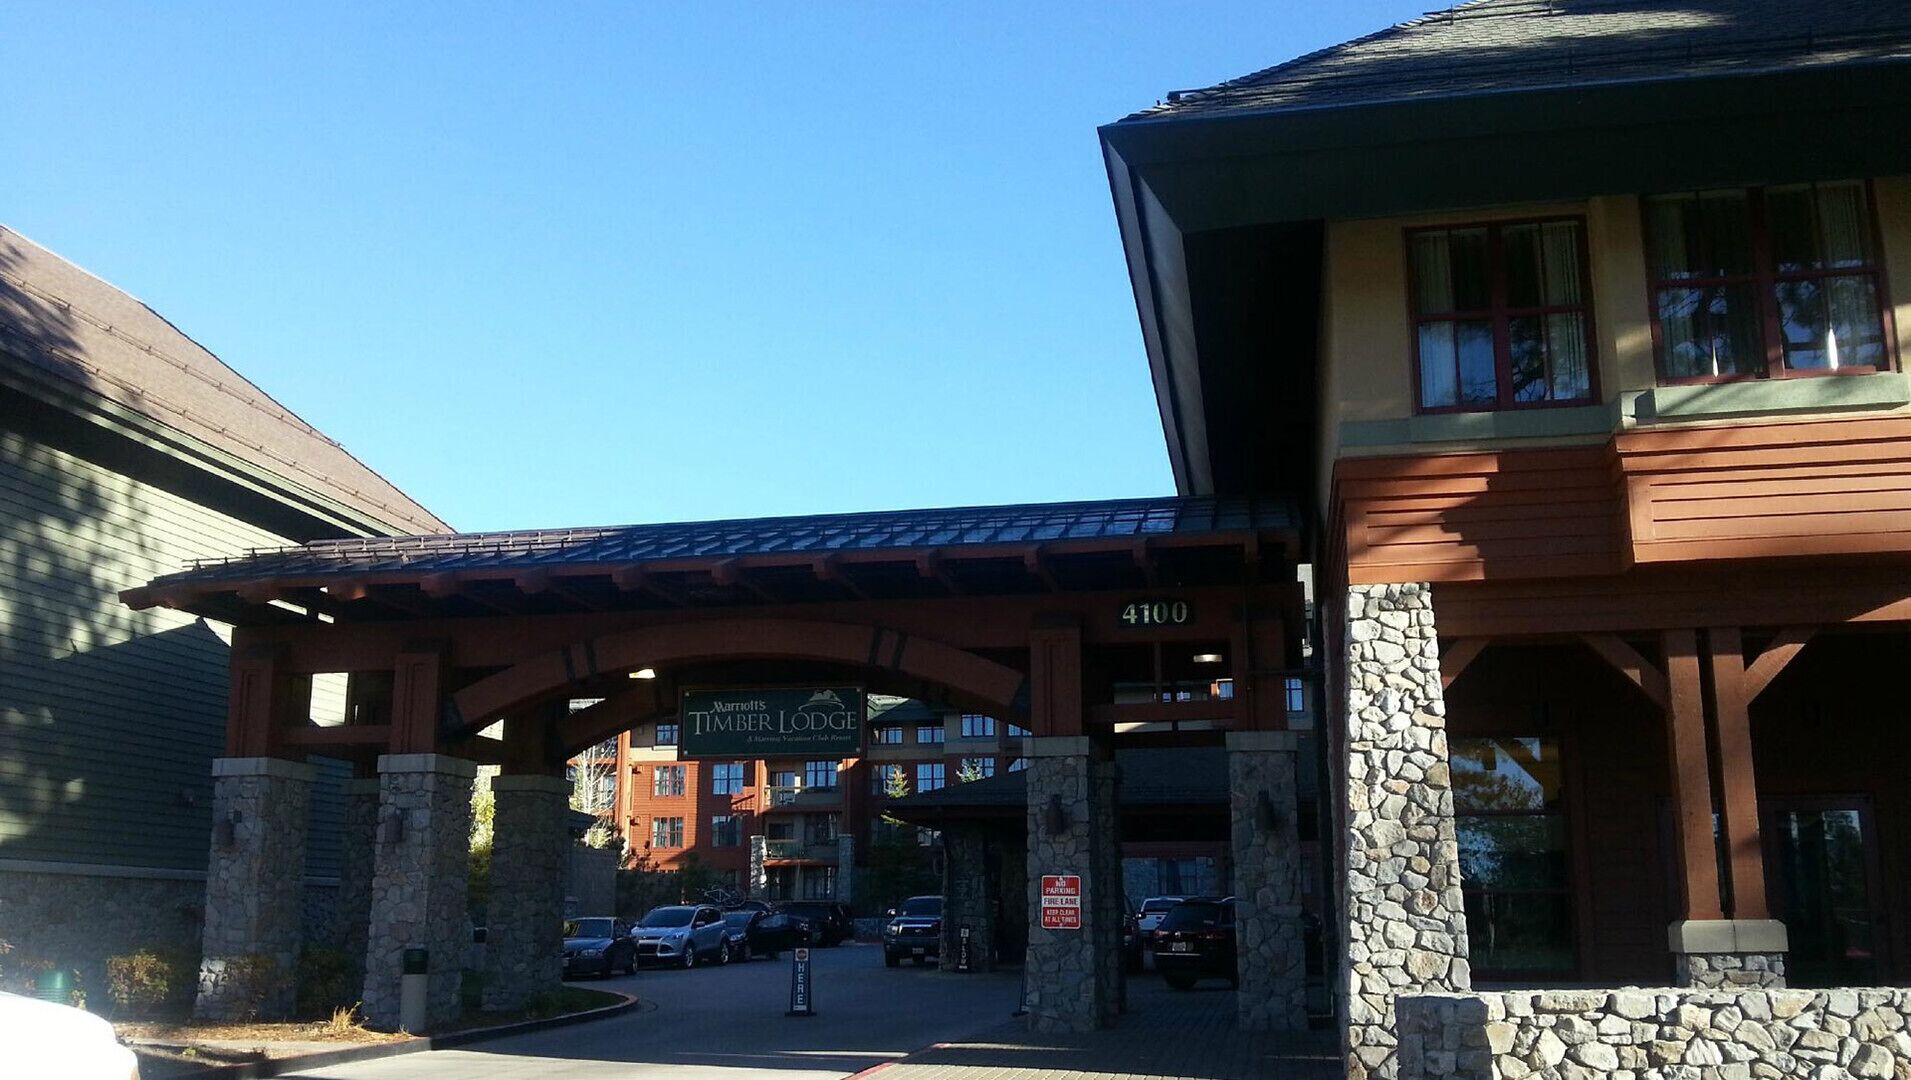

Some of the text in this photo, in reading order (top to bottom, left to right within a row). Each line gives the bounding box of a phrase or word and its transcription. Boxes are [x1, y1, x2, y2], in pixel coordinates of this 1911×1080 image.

[1122, 602, 1187, 624] 4100
[710, 700, 767, 713] Marriott's
[688, 710, 858, 736] TIMBER LODGE
[1045, 887, 1076, 895] PARKING
[1043, 897, 1079, 906] FIRE LANE
[797, 962, 805, 1004] HERE
